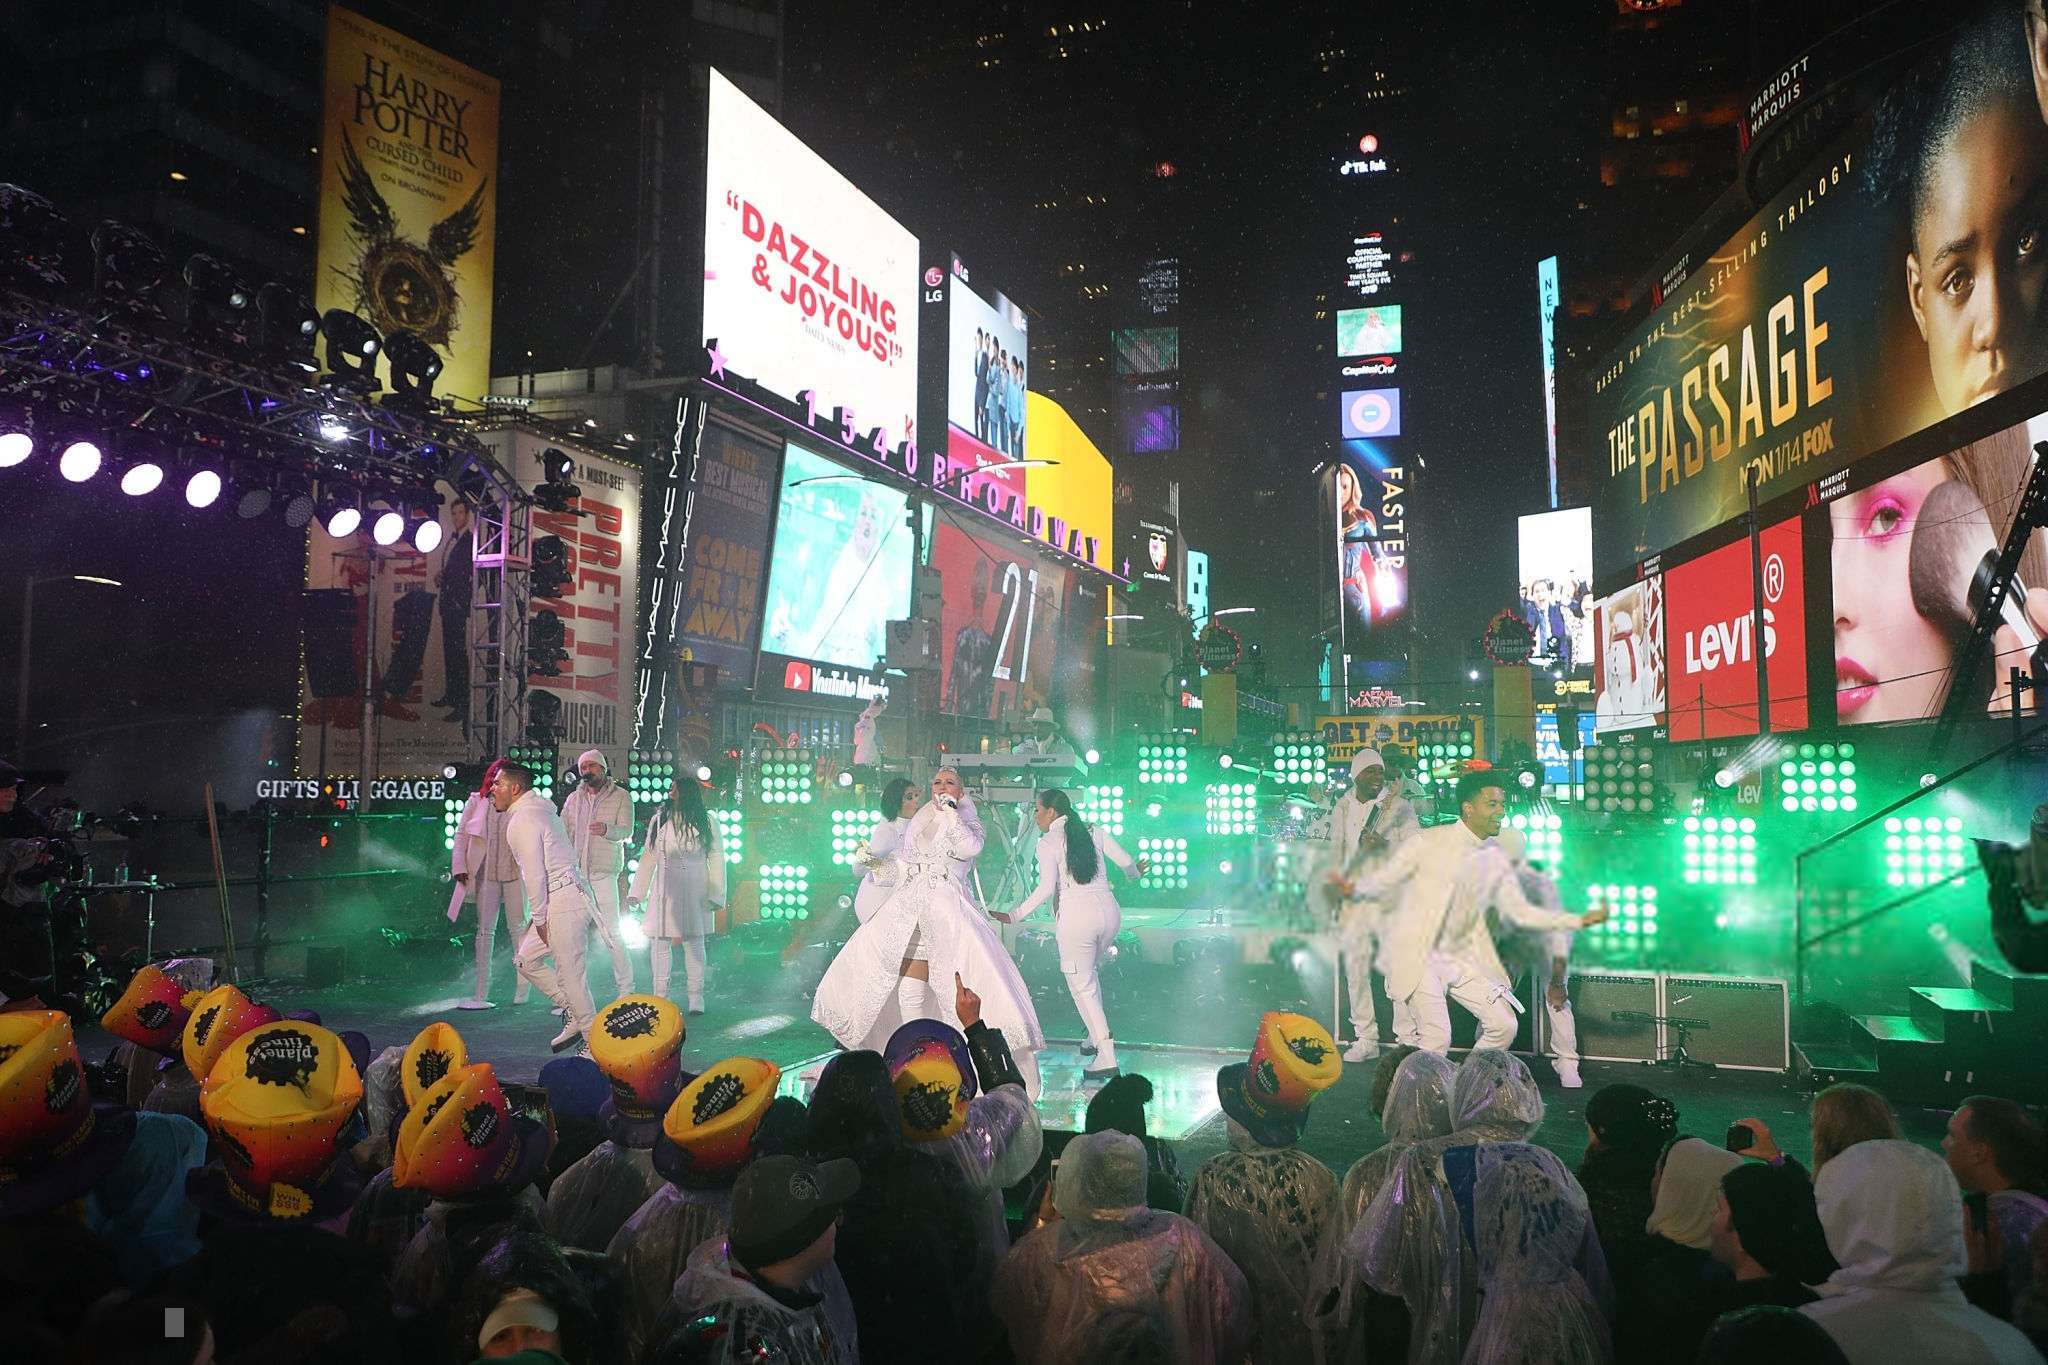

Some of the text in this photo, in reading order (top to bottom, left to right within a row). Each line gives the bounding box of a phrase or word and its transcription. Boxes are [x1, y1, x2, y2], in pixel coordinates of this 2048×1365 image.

[362, 52, 472, 131] HARRY
[1750, 56, 1809, 118] MARRIOTT
[352, 83, 478, 169] POTTER
[1751, 83, 1801, 136] MARQUIS
[366, 136, 464, 183] CURSED CHILD
[381, 173, 397, 185] ON
[752, 253, 772, 292] &
[1597, 153, 1852, 394] BASED ON THE BEST-SELLING TRILOGY
[1662, 253, 1690, 286] MARRIOTT
[1662, 270, 1688, 299] MARQUIS
[925, 289, 943, 303] LG
[1608, 266, 1833, 505] THE PASSAGE
[1802, 417, 1835, 463] FOX
[804, 389, 1100, 564] 1540 BROADWAY
[1819, 468, 1850, 489] MARRIOTT
[1820, 482, 1847, 501] MARQUIS
[1382, 466, 1405, 569] FASTER
[694, 530, 762, 580] COME
[574, 496, 623, 701] PRETTY
[683, 599, 756, 642] AWAY
[992, 562, 1040, 683] 21
[1199, 645, 1230, 656] planet
[1489, 637, 1524, 648] planet
[812, 666, 857, 698] YouTube
[1349, 696, 1406, 708] MARVEL
[558, 701, 618, 746] MUSICAL
[1322, 720, 1476, 744] GET DOW
[256, 780, 445, 800] GIFTS LUGGAGE
[617, 1007, 653, 1029] planet
[260, 1045, 312, 1063] planet
[469, 1113, 491, 1145] planet
